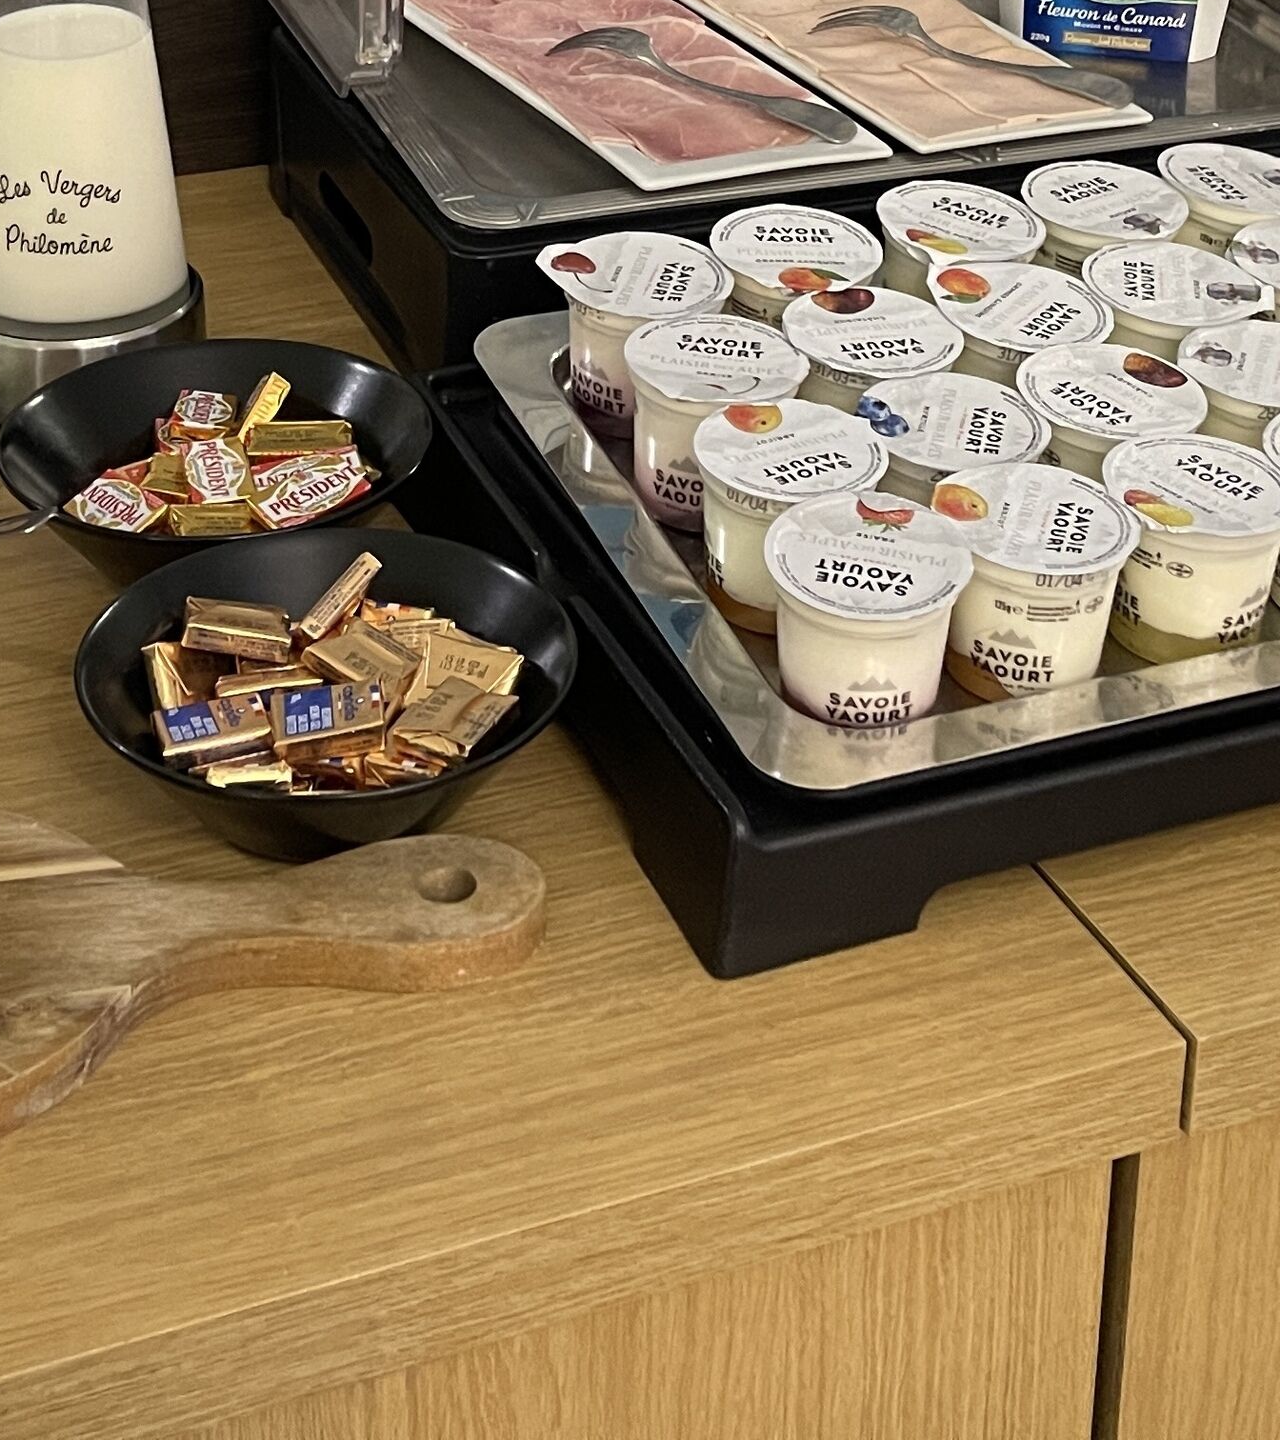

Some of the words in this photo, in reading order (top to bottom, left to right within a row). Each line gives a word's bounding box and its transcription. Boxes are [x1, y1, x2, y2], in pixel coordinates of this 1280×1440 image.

[1102, 10, 1118, 23] de
[1121, 7, 1187, 29] Canard
[40, 169, 121, 208] Vergers
[1050, 176, 1107, 196] SAVOIE
[1058, 182, 1119, 204] YAOURT
[1186, 166, 1237, 200] SAVOIE
[1197, 165, 1248, 201] YAOURT
[46, 208, 68, 225] de
[932, 201, 1007, 229] YAOURT
[939, 196, 1010, 223] SAVOIE
[5, 223, 114, 255] Philomène
[753, 233, 835, 244] YAOURT
[756, 225, 830, 236] SAVOIE
[650, 262, 679, 302] YAOURT
[666, 265, 695, 303] SAVOIE
[1124, 261, 1139, 298] SAVOIE
[1140, 262, 1155, 301] YAOURT
[1019, 301, 1068, 337] YAOURT
[1035, 308, 1081, 340] SAVOIE
[676, 342, 764, 359] YAOURT
[681, 334, 762, 350] SAVOIE
[840, 338, 922, 352] YAOURT
[848, 346, 925, 360] SAVOIE
[1050, 386, 1121, 426] SAVOIE
[1057, 381, 1133, 423] YAOURT
[964, 407, 989, 454] YAOURT
[983, 411, 1007, 455] SAVOIE
[762, 452, 846, 478] YAOURT
[776, 460, 852, 485] SAVOIE
[1187, 454, 1265, 495] SAVOIE
[654, 481, 701, 507] YAOU
[655, 469, 704, 492] SAVO
[1175, 458, 1259, 502] YAOURT
[1045, 502, 1074, 553] YAOURT
[1066, 506, 1094, 554] SAVOIE
[815, 558, 914, 585] YAOURT
[816, 571, 908, 596] SAVOIE
[970, 651, 1055, 684] YAOURT
[973, 639, 1052, 669] SAVOIE
[825, 705, 912, 724] YAOURT
[829, 691, 912, 710] SAVOIE
